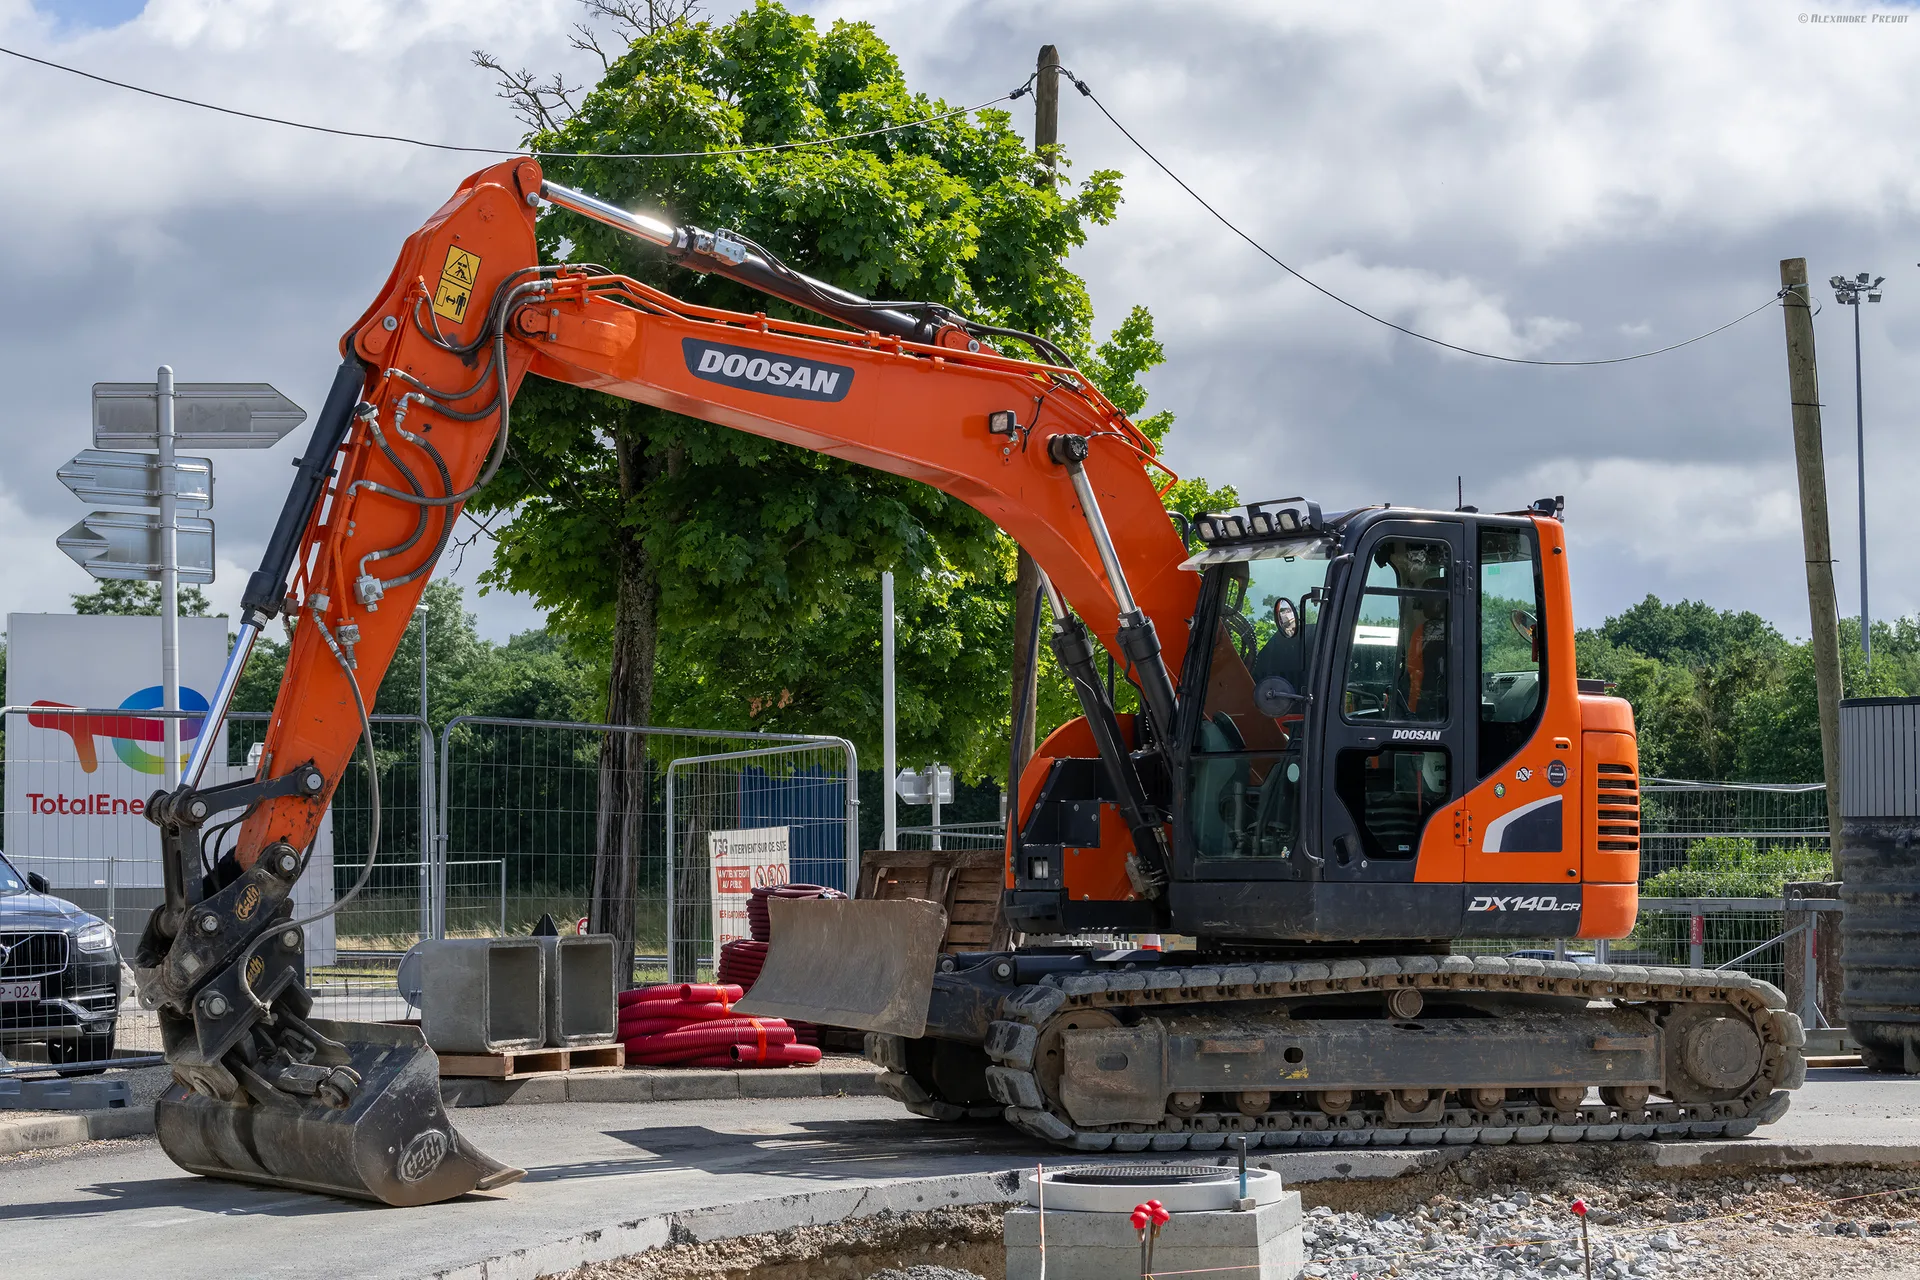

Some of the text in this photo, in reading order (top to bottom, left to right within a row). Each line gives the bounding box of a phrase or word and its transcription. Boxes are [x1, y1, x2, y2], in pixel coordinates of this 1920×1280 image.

[697, 349, 840, 395] DOOSAN
[1391, 729, 1442, 741] DOOSAN
[26, 793, 145, 815] TotalEne
